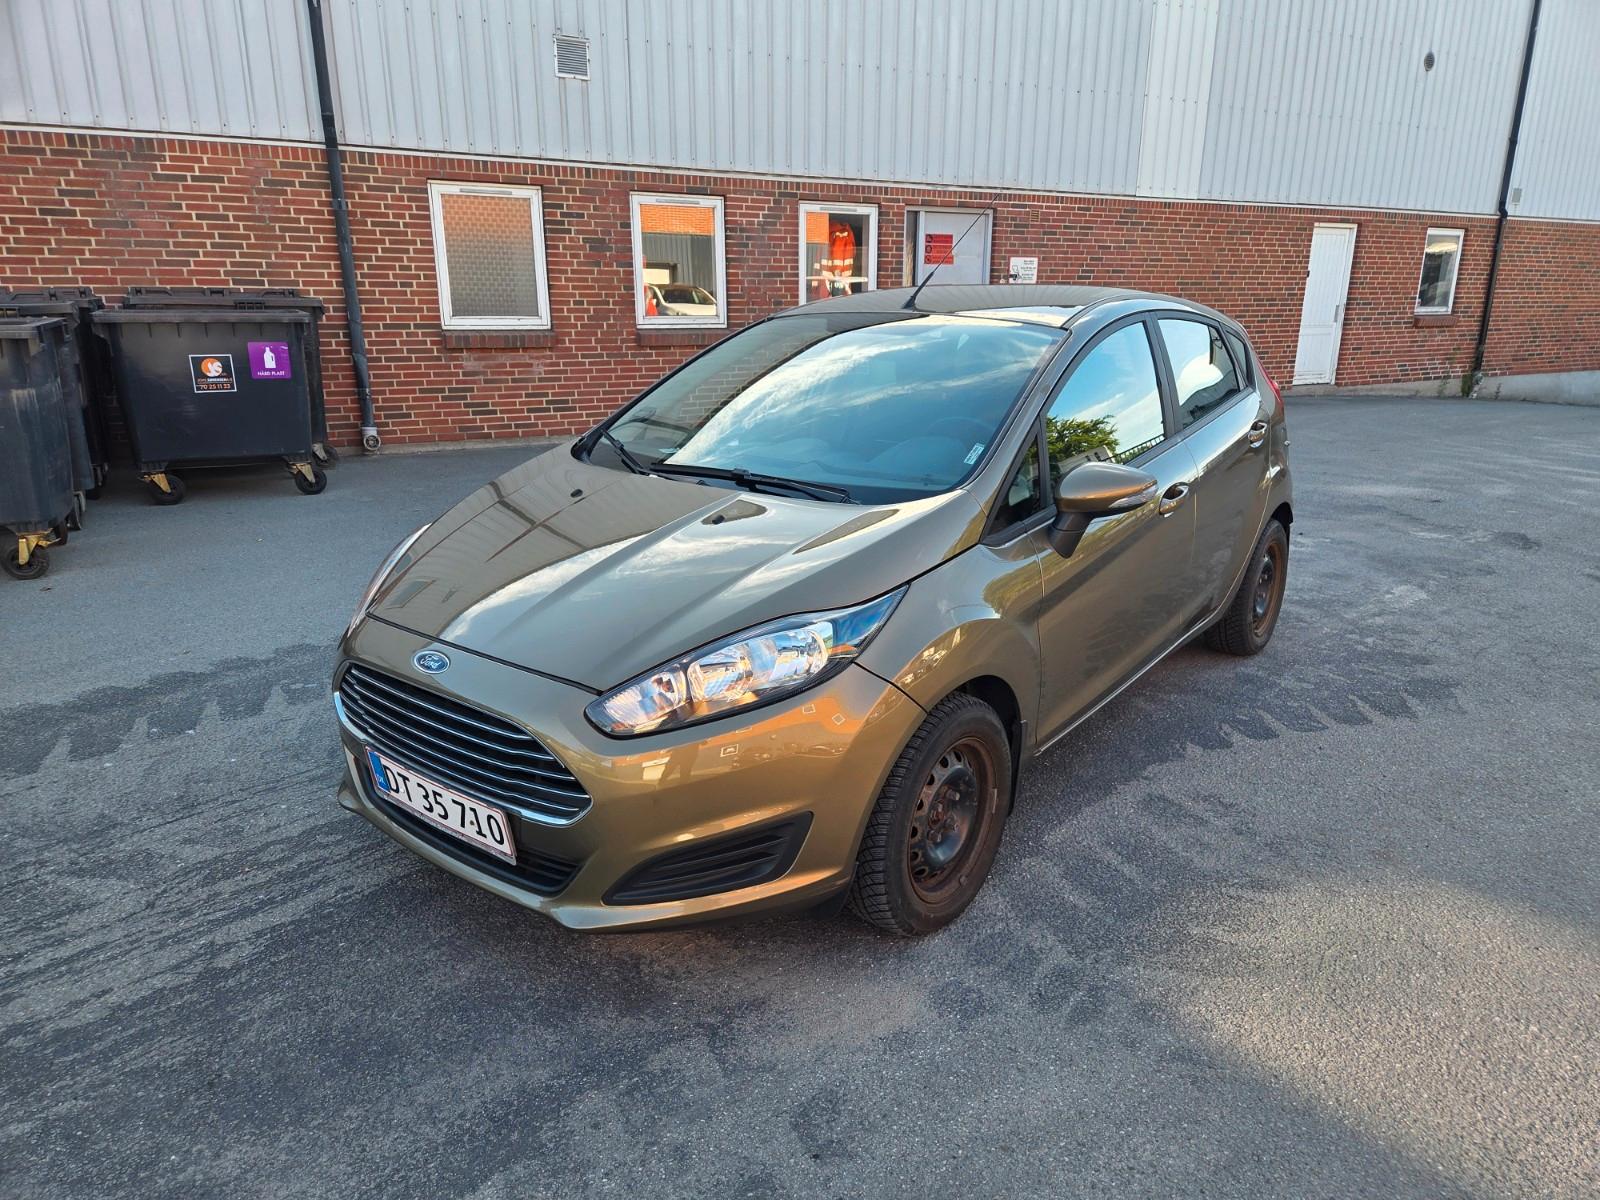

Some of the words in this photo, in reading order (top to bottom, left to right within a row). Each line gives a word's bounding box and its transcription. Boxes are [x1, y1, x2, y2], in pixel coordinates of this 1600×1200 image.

[384, 764, 412, 802] DT
[417, 782, 449, 821] 35
[451, 798, 505, 846] 710
